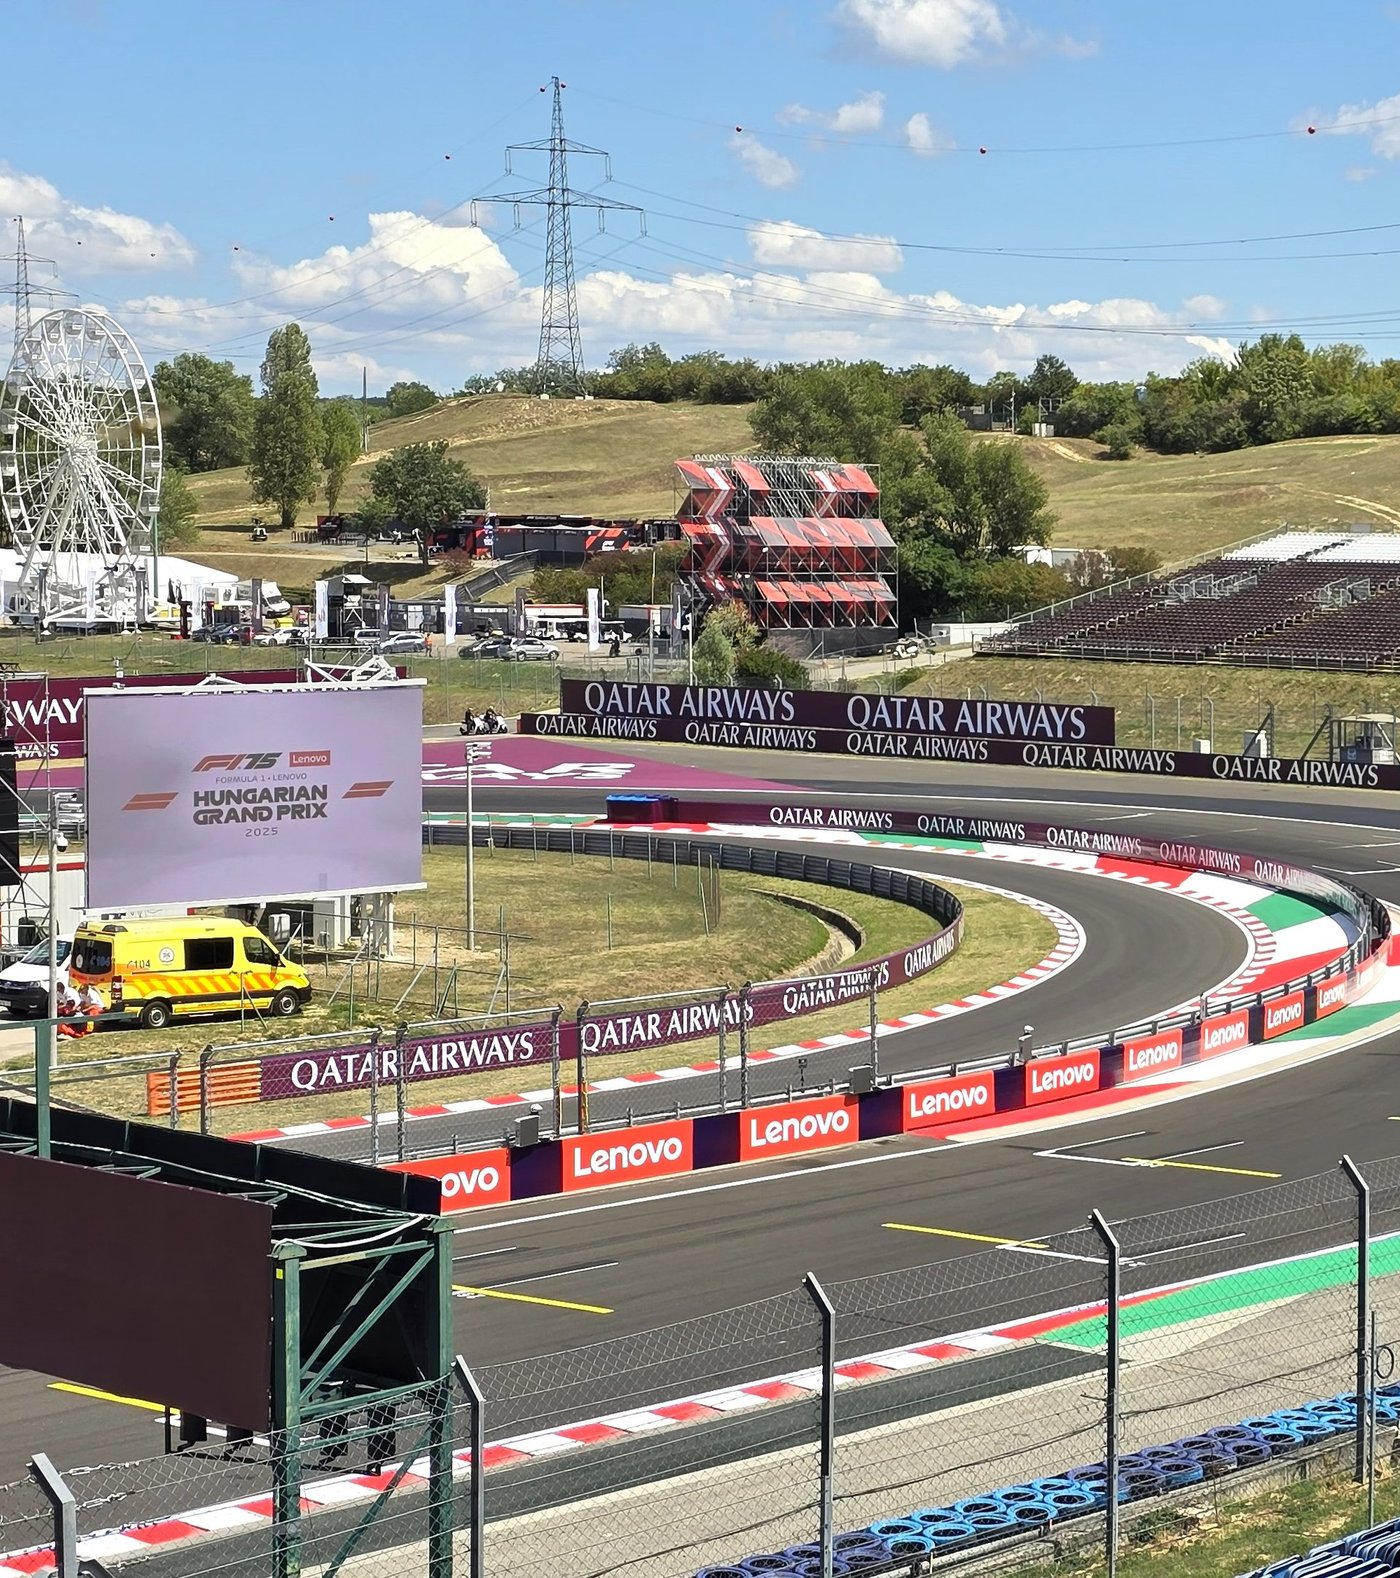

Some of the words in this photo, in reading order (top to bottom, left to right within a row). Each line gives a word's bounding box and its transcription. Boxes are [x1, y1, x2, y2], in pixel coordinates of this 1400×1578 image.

[584, 682, 672, 716] QATAR
[679, 687, 795, 722] AIRWAYS
[535, 715, 588, 735] QATAR
[590, 717, 658, 738] AIRWAYS
[846, 695, 947, 731] QATAR
[954, 701, 1086, 740] AIRWAYS
[685, 721, 739, 744] QATAR
[743, 726, 817, 750] AIRWAYS
[846, 732, 909, 755] QATAR
[911, 737, 989, 761] AIRWAYS
[292, 754, 328, 764] Lenovo
[1022, 743, 1088, 767] QATAR
[1091, 748, 1176, 773] AIRWAYS
[1212, 755, 1282, 780] QATAR
[1287, 760, 1379, 786] AIRWAYS
[215, 775, 258, 784] FORMULA
[260, 774, 266, 782] 1
[272, 772, 308, 782] LENOVO
[193, 784, 328, 807] HUNGARIAN
[192, 805, 274, 826] GRAND
[276, 802, 329, 821] PRIX
[769, 806, 824, 825] QATAR
[827, 809, 893, 830] AIRWAYS
[917, 815, 965, 835] QATAR
[968, 818, 1026, 841] AIRWAYS
[245, 826, 279, 838] 2025
[1046, 826, 1090, 849] QATAR
[1091, 832, 1142, 856] AIRWAYS
[1159, 842, 1197, 865] QATAR
[1199, 849, 1241, 873] AIRWAYS
[1254, 859, 1285, 885] QATAR
[904, 944, 932, 978] QATAR
[783, 977, 836, 1013] QATAR
[1319, 985, 1345, 1009] Lenovo
[1267, 1002, 1302, 1029] Lenovo
[582, 1012, 662, 1052] QATAR
[1204, 1021, 1245, 1050] Lenovo
[291, 1048, 399, 1091] QATAR
[410, 1031, 534, 1075] AIRWAYS
[1129, 1041, 1178, 1071] Lenovo
[1031, 1063, 1094, 1094] Lenovo
[910, 1085, 988, 1118] Lenovo
[750, 1109, 850, 1147] Lenovo
[574, 1136, 682, 1178] Lenovo
[440, 1166, 499, 1198] ovo
